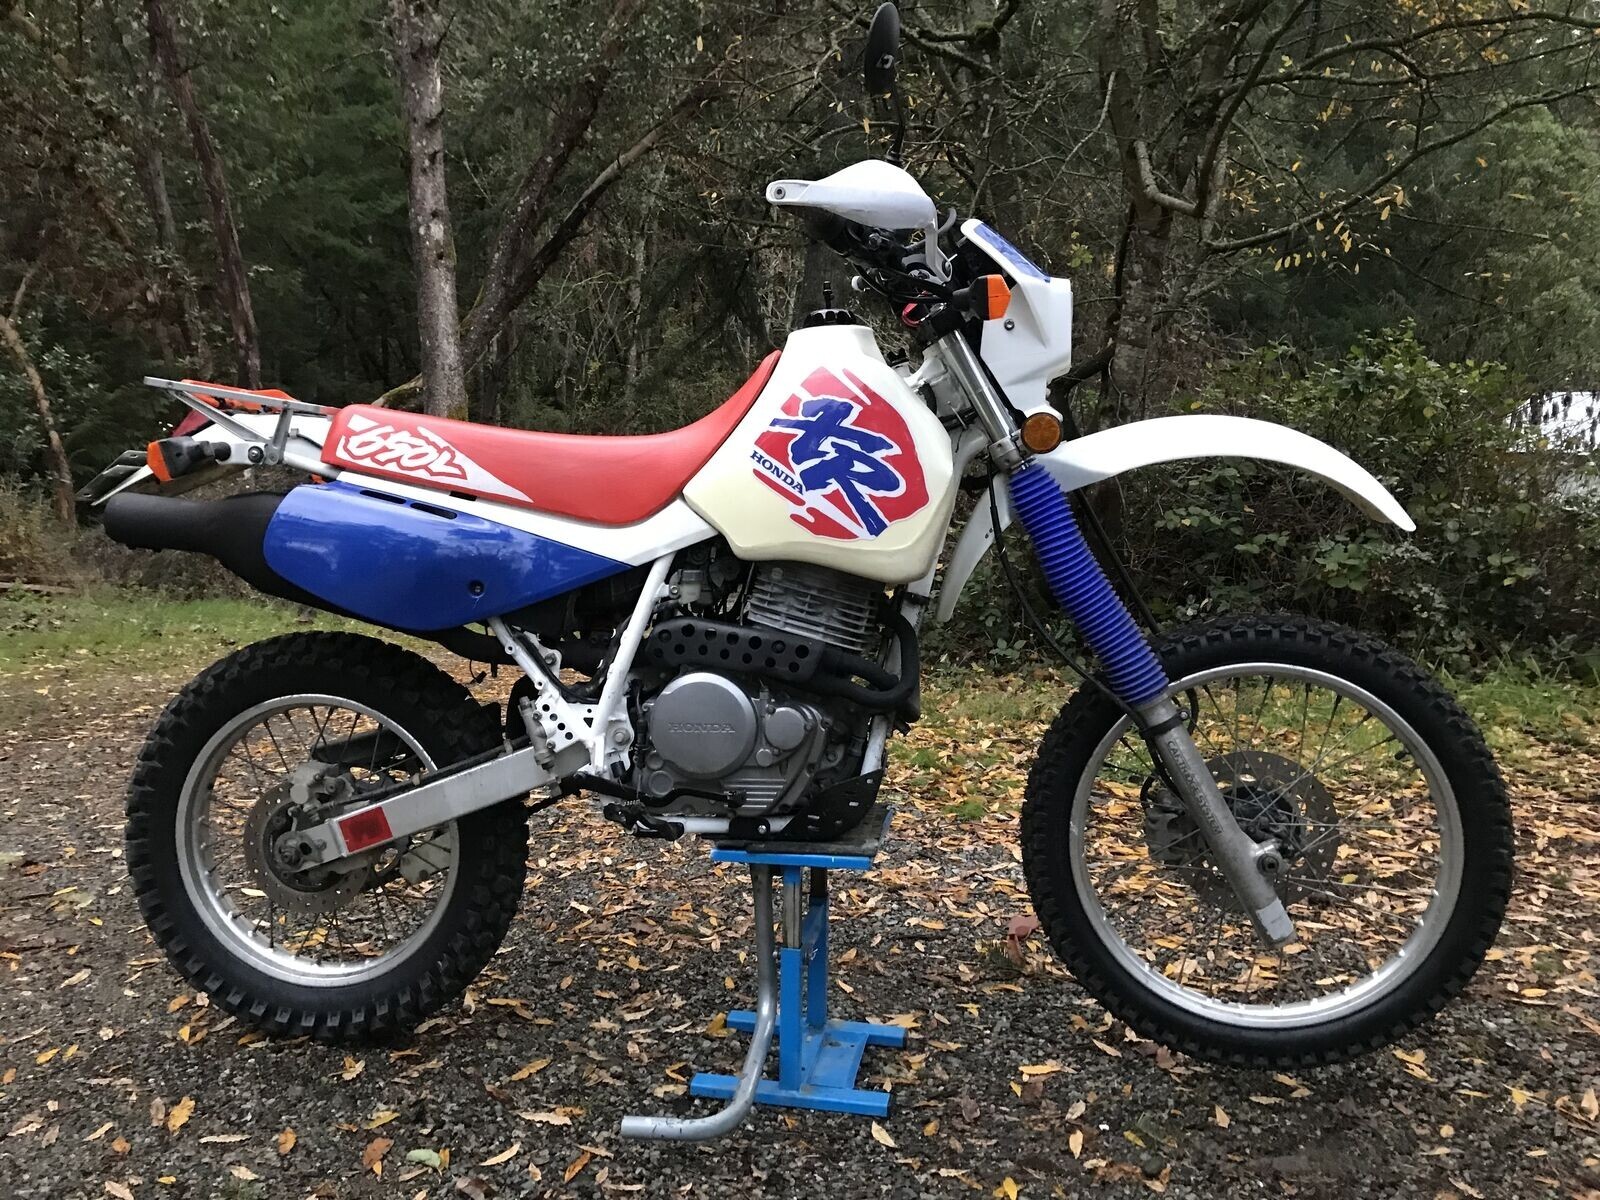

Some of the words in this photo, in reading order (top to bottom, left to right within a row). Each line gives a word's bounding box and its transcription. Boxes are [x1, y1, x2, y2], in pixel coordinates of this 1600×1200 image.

[346, 425, 463, 475] 650L
[749, 450, 804, 495] HONDA
[667, 722, 736, 734] HONDA
